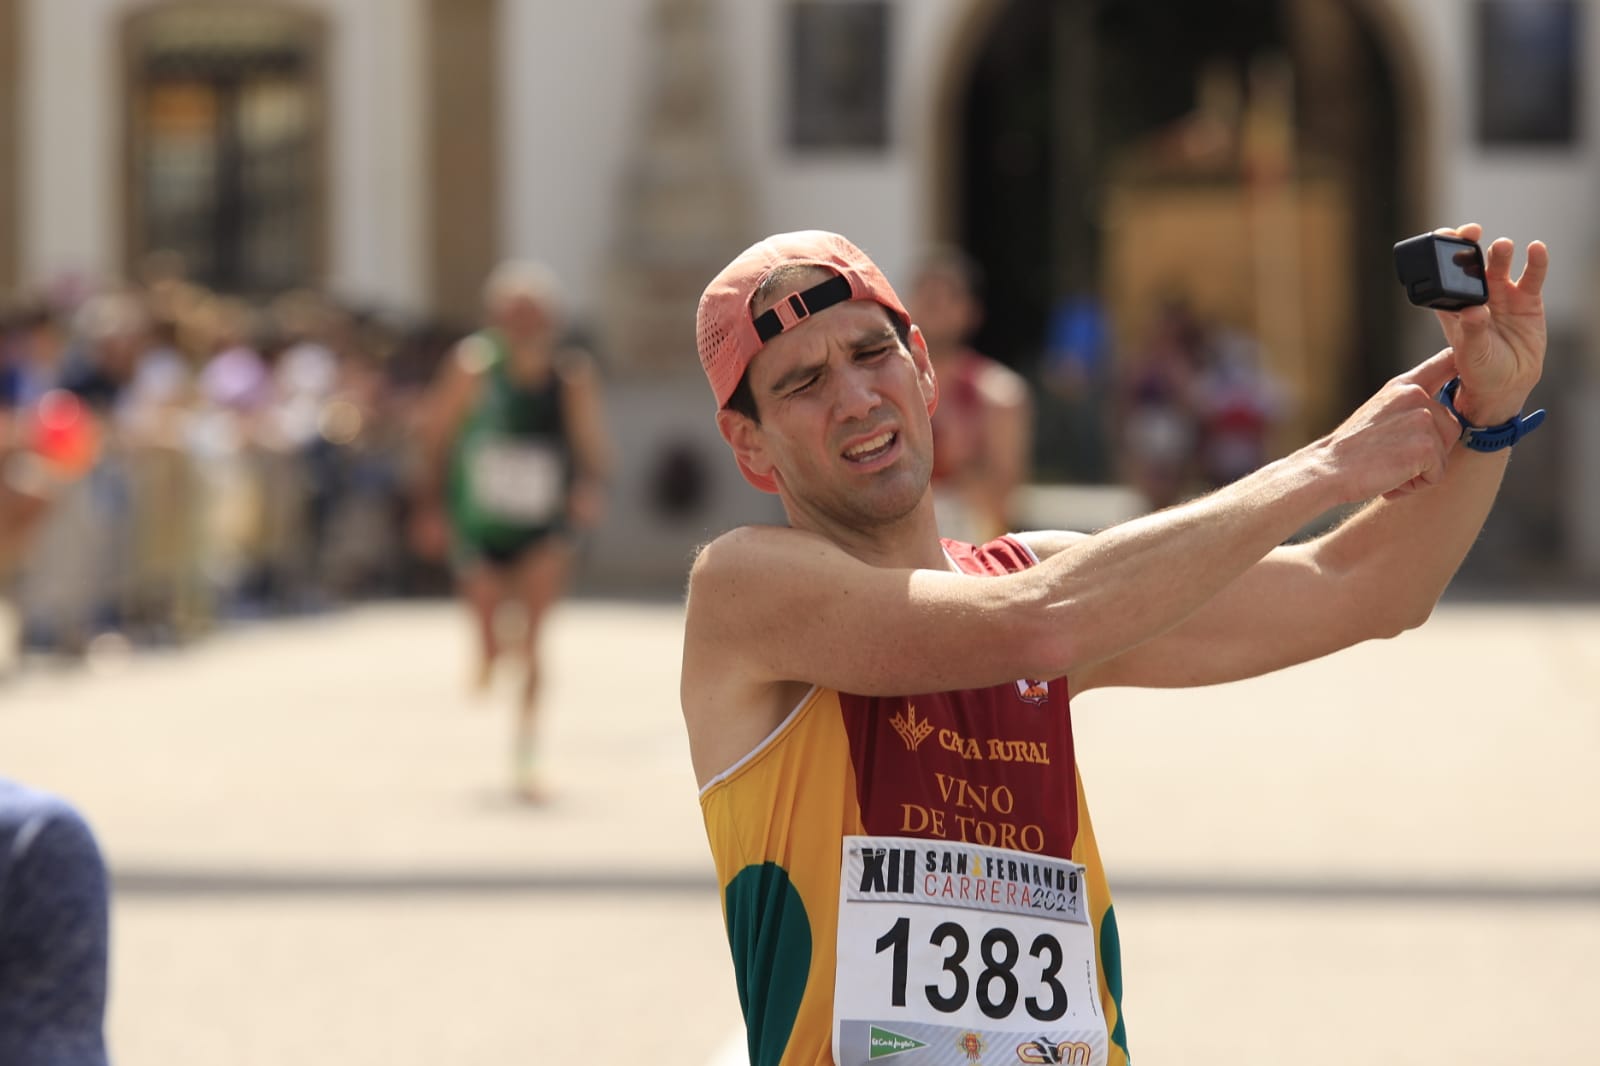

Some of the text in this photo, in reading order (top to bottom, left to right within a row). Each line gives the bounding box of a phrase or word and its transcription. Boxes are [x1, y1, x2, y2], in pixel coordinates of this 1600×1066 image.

[986, 738, 1050, 765] RURAL
[934, 772, 1014, 815] VINO
[900, 803, 1045, 853] DE TORO
[859, 847, 1079, 894] XII SAN FERNANDO
[923, 874, 1078, 915] CARRERA 2024
[875, 917, 1068, 1022] 1383
